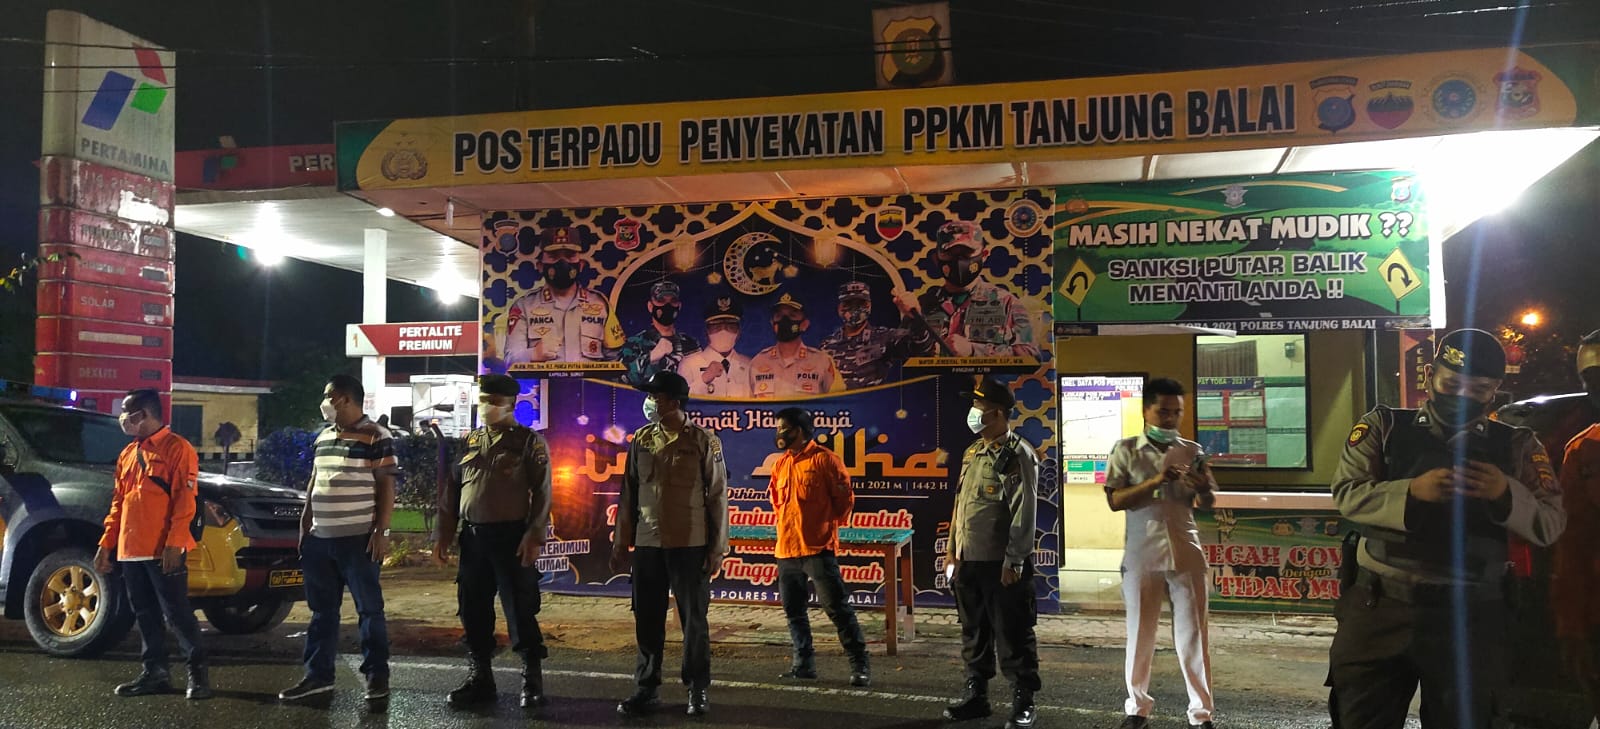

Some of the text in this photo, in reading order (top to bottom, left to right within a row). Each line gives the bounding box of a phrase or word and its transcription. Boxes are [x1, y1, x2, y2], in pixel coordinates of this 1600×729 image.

[454, 83, 1298, 175] POS TERPADU PENYEKATAN PPKM TANJUNG BALAI
[81, 137, 169, 176] PERTAMINA
[1068, 222, 1158, 248] MASIH
[1166, 217, 1268, 243] NEKAT
[1271, 213, 1371, 240] MUDIK
[1108, 252, 1367, 280] SANKSI PUTAR BALIK
[1128, 280, 1239, 304] MENANTI
[1243, 279, 1320, 301] ANDA
[80, 295, 116, 310] SOLAR
[399, 325, 463, 338] PERTALITE
[1240, 320, 1284, 331] POLRES
[1287, 319, 1339, 330] TANJUNG
[1341, 319, 1377, 330] BALAI
[398, 339, 453, 351] PREMIUM
[868, 481, 890, 490] 2021
[912, 481, 937, 490] 1442
[939, 481, 948, 490] H
[852, 509, 913, 529] untuk
[1202, 544, 1281, 567] EGAH
[1281, 568, 1331, 578] Dengan
[720, 590, 768, 600] POLRES
[1216, 576, 1302, 600] TIDAK
